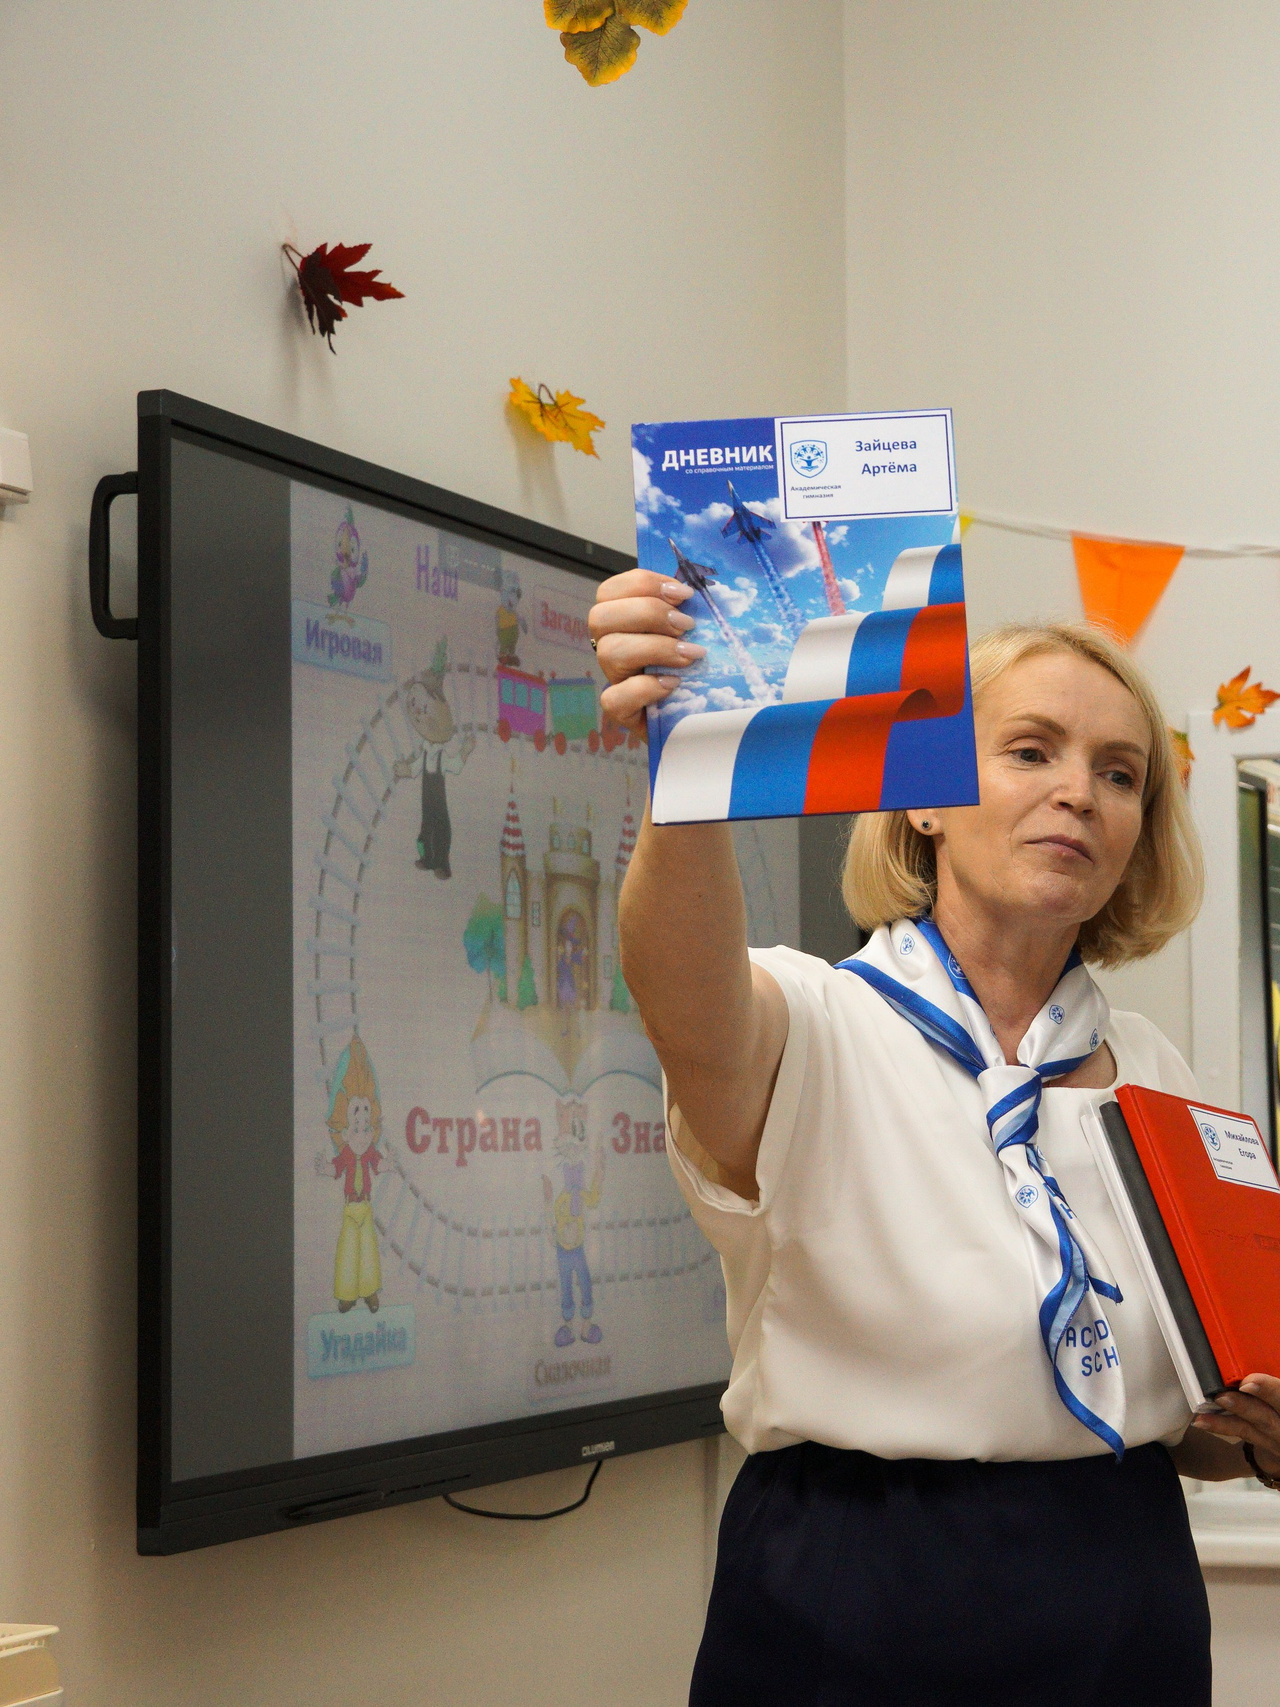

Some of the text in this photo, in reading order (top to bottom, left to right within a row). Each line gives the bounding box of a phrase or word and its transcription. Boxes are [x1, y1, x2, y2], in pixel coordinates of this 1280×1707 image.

[855, 439, 917, 453] Зайцева
[661, 444, 774, 472] ДНЕВНИК
[694, 466, 734, 475] справочным
[735, 464, 774, 472] материалом
[861, 462, 917, 477] Артёма
[790, 484, 842, 492] Академическая
[416, 544, 458, 601] Наш
[305, 618, 383, 666] Игровая
[405, 1107, 543, 1167] Страна
[1224, 1130, 1260, 1146] Михайлова
[1238, 1148, 1257, 1161] Егора
[320, 1322, 407, 1362] Угадайка
